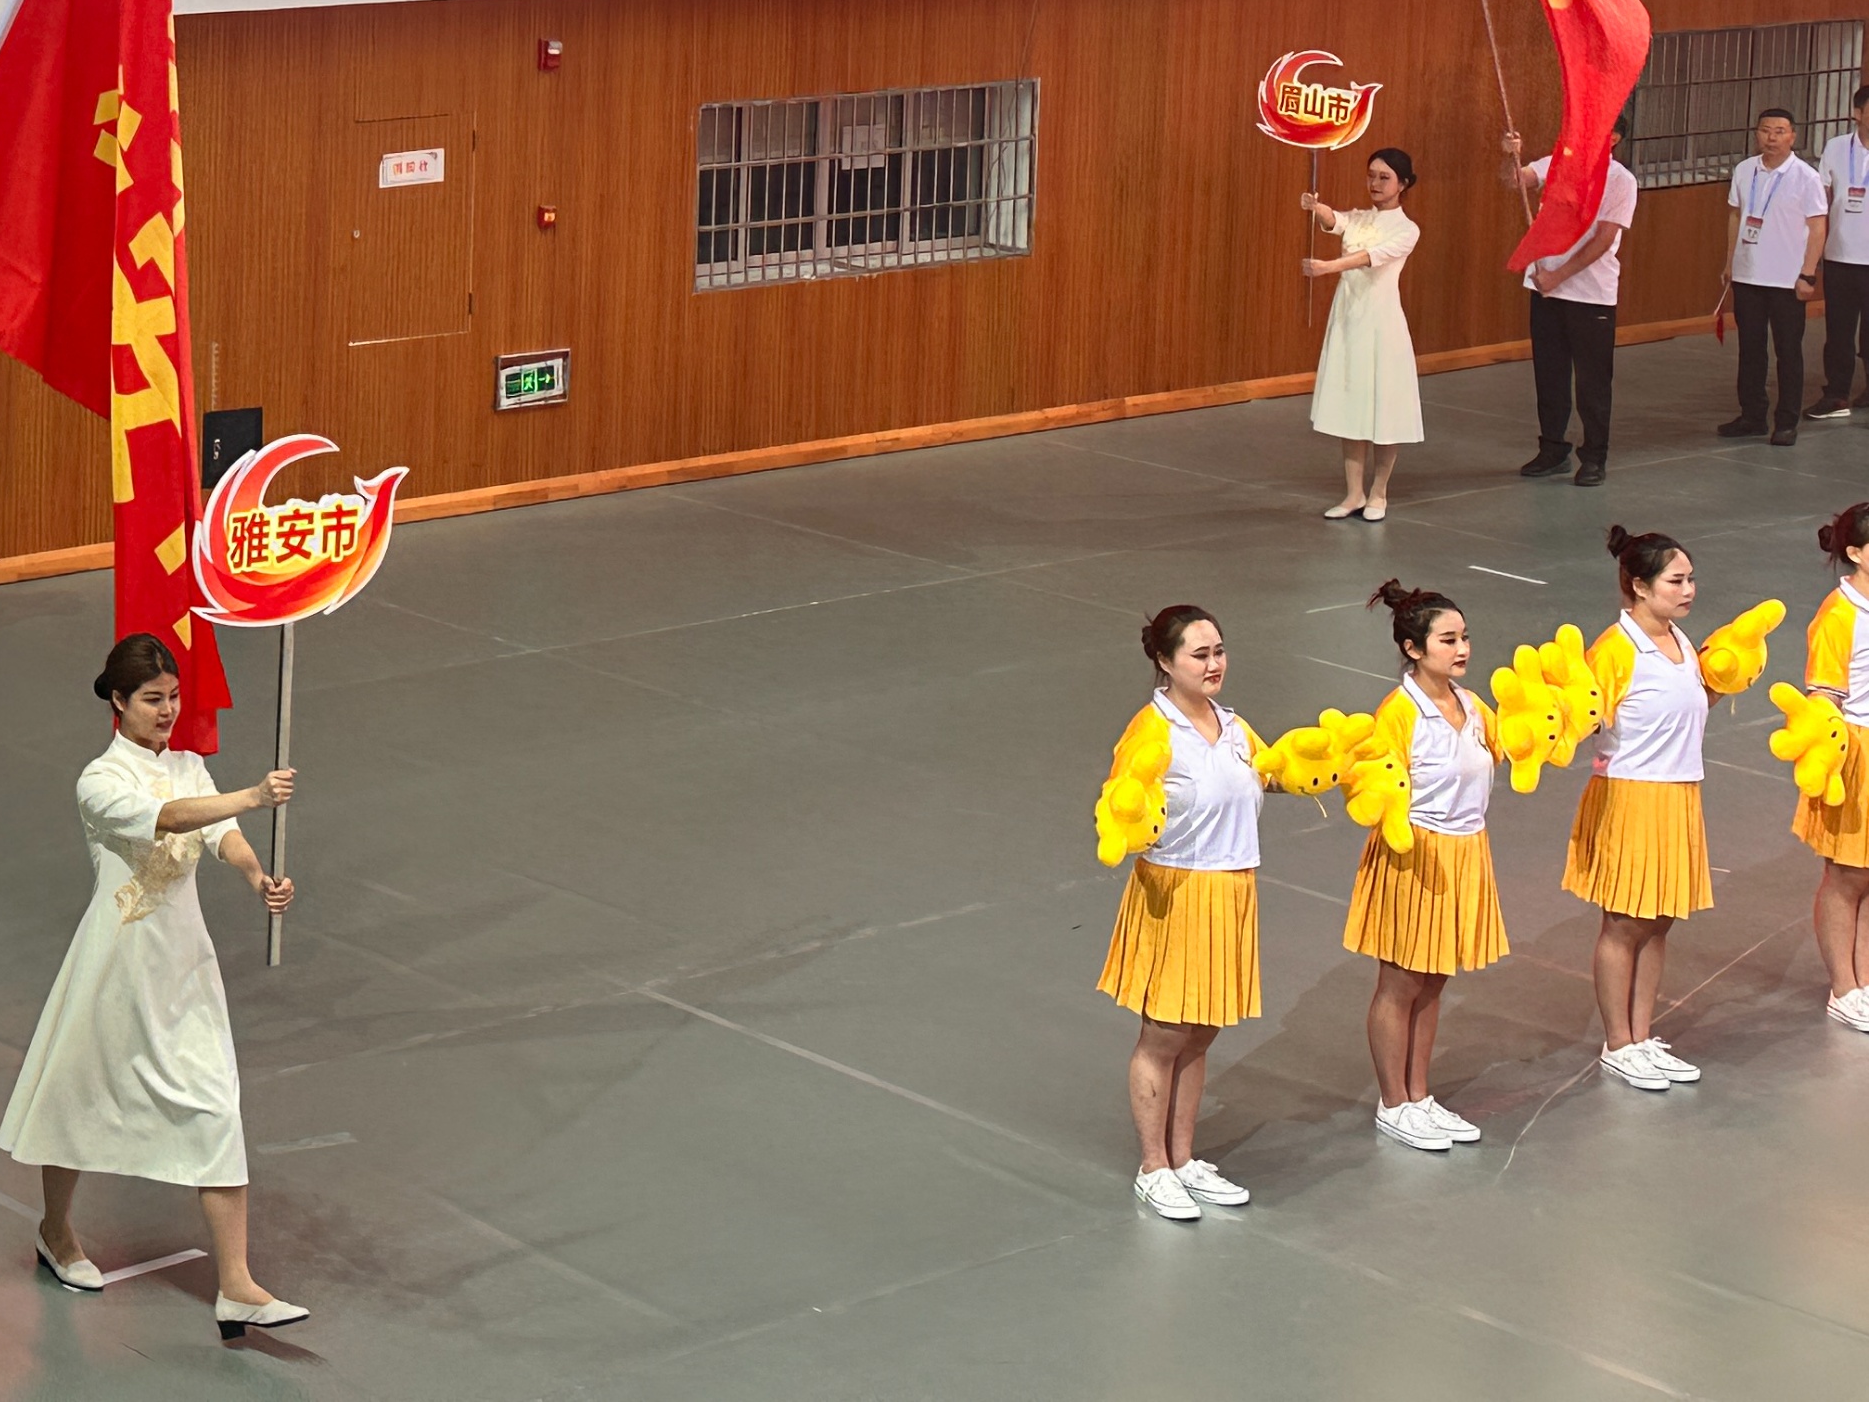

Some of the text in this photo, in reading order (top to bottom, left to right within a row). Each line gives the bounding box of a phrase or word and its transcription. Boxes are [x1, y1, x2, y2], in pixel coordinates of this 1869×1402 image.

[1279, 83, 1351, 123] 眉山市
[230, 504, 358, 569] 雅安市
